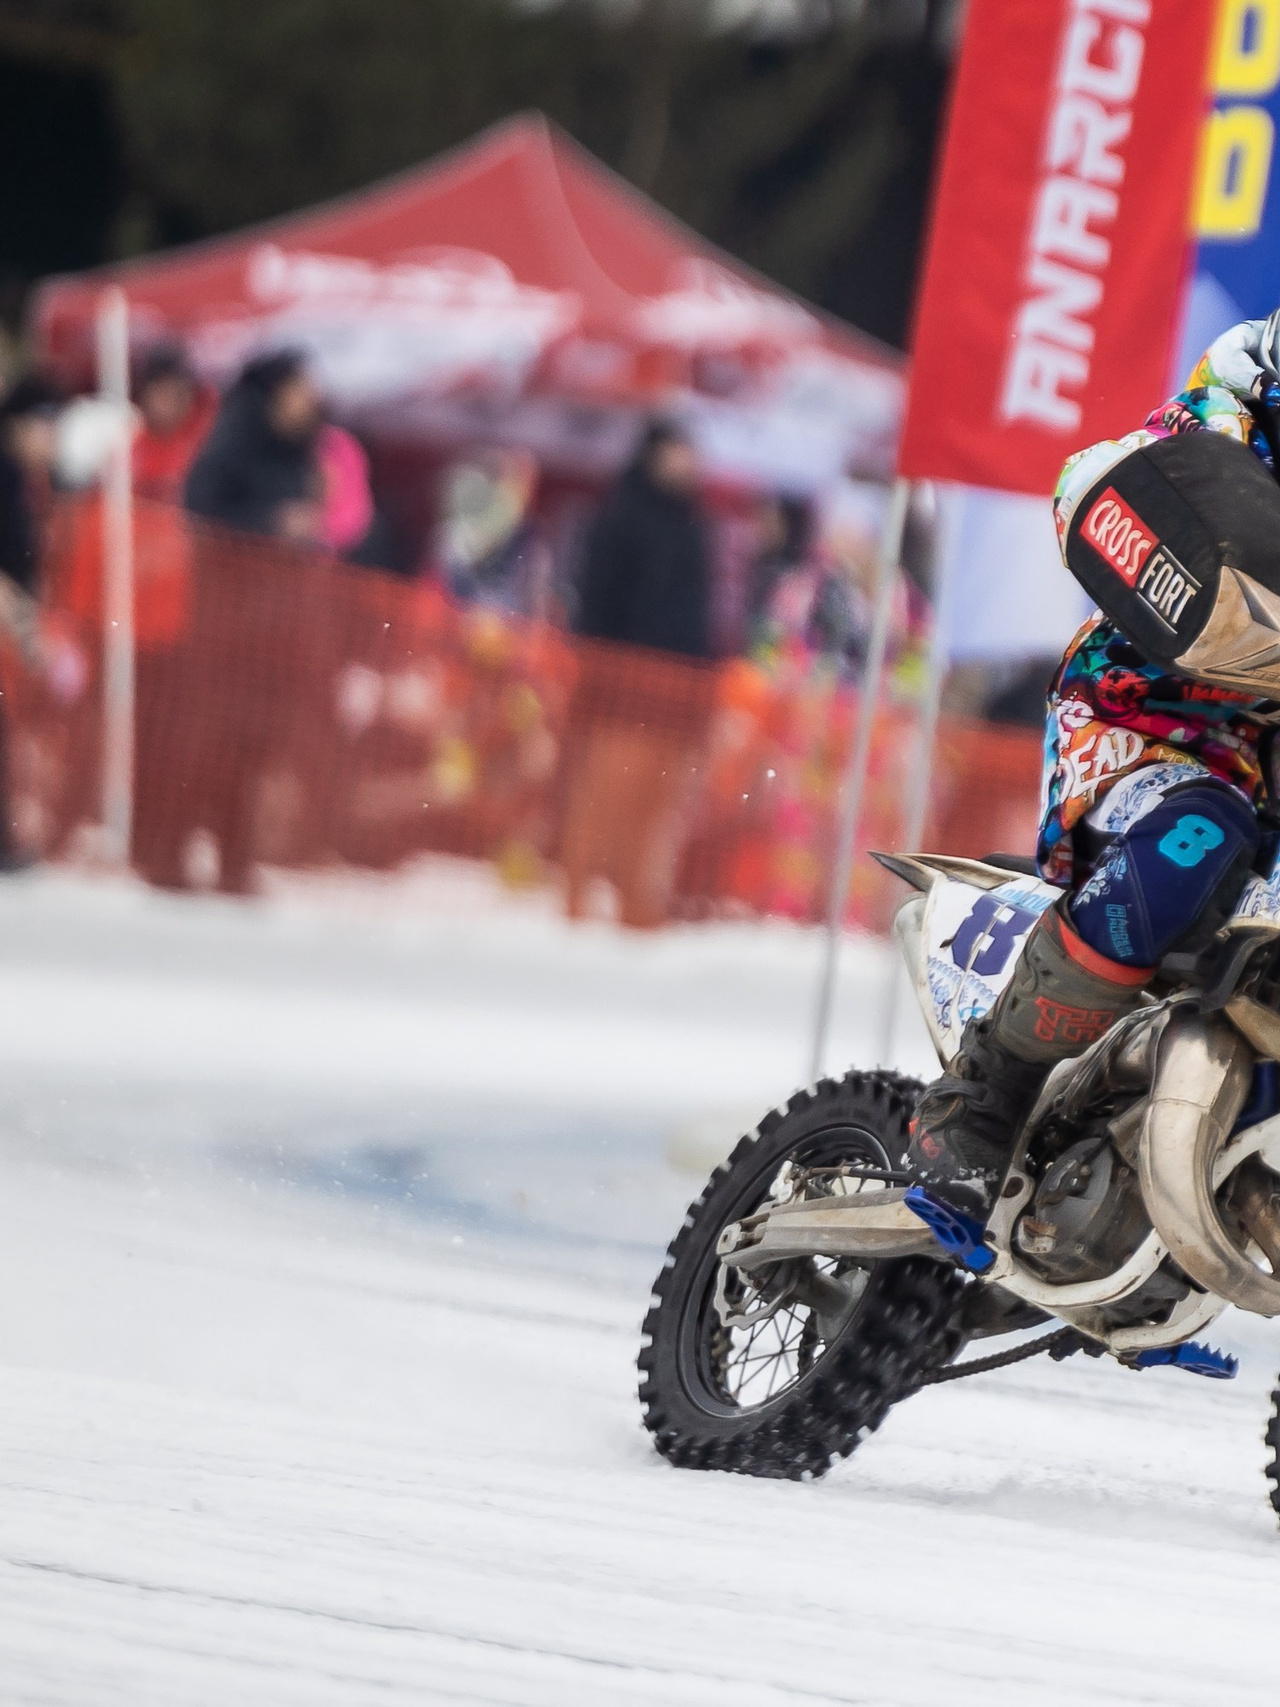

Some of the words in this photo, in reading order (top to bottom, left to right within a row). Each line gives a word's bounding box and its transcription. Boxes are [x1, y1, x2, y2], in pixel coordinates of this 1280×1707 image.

[1002, 0, 1152, 434] ANARC
[1088, 499, 1153, 576] CROSS
[1139, 552, 1198, 624] FORT
[1158, 813, 1226, 868] 8
[951, 893, 1040, 977] 8
